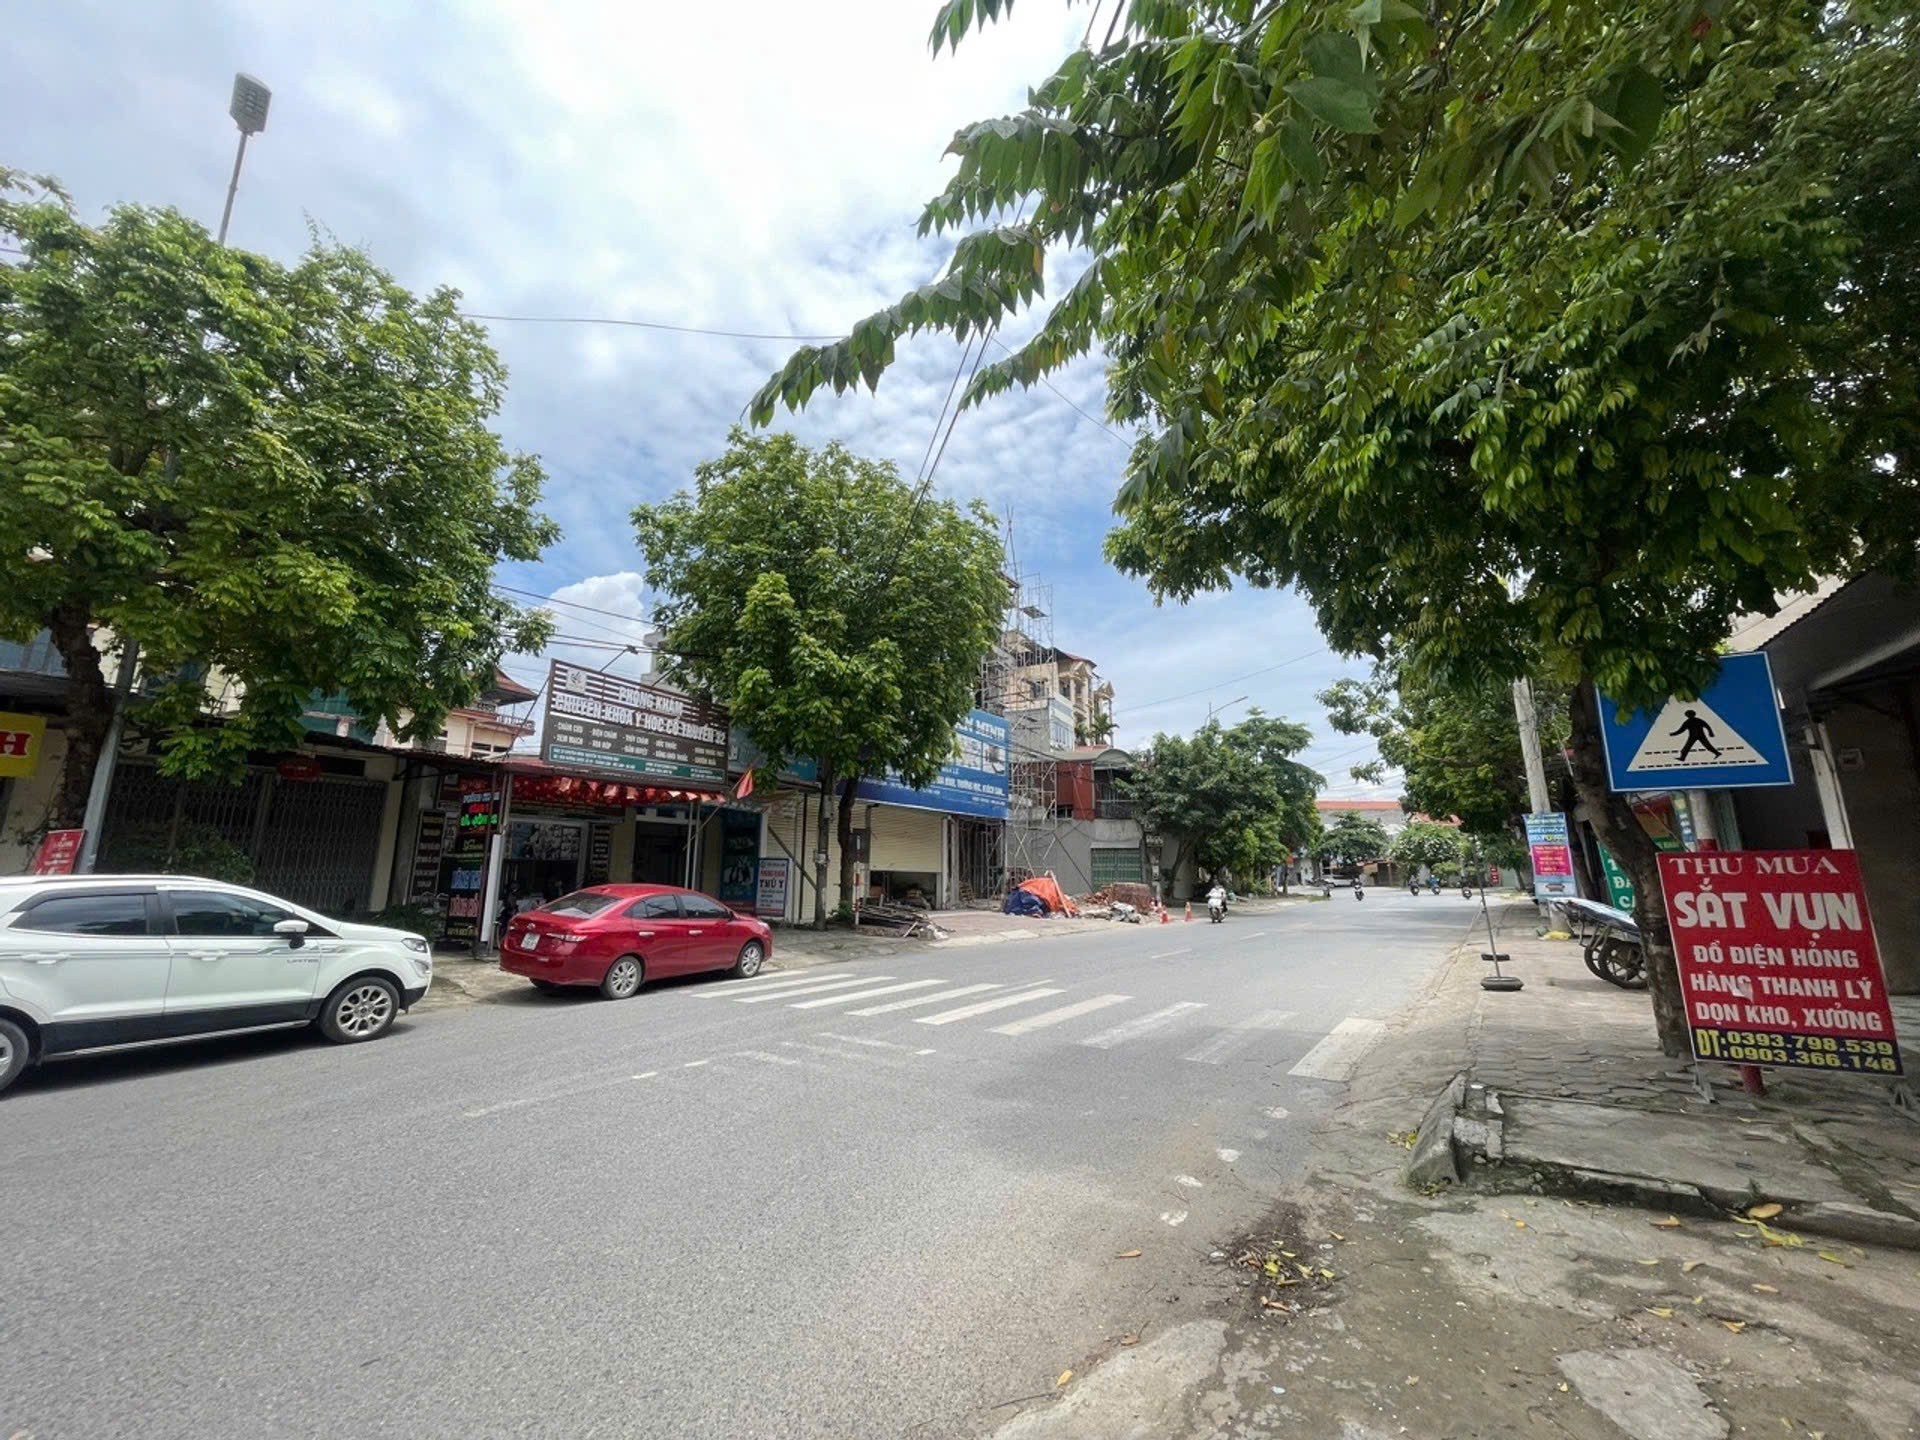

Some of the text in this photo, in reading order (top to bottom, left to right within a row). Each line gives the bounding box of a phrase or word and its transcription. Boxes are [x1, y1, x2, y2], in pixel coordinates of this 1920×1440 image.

[1668, 856, 1840, 874] THU MUA
[1674, 877, 1863, 939] SẮT VỤN
[1730, 943, 1784, 969] ĐIỆN
[1791, 941, 1860, 969] HỎNG
[1758, 976, 1839, 998] THANH
[1845, 976, 1873, 999] LÝ
[1695, 1001, 1884, 1032] DỌN KHO, XƯỞNG
